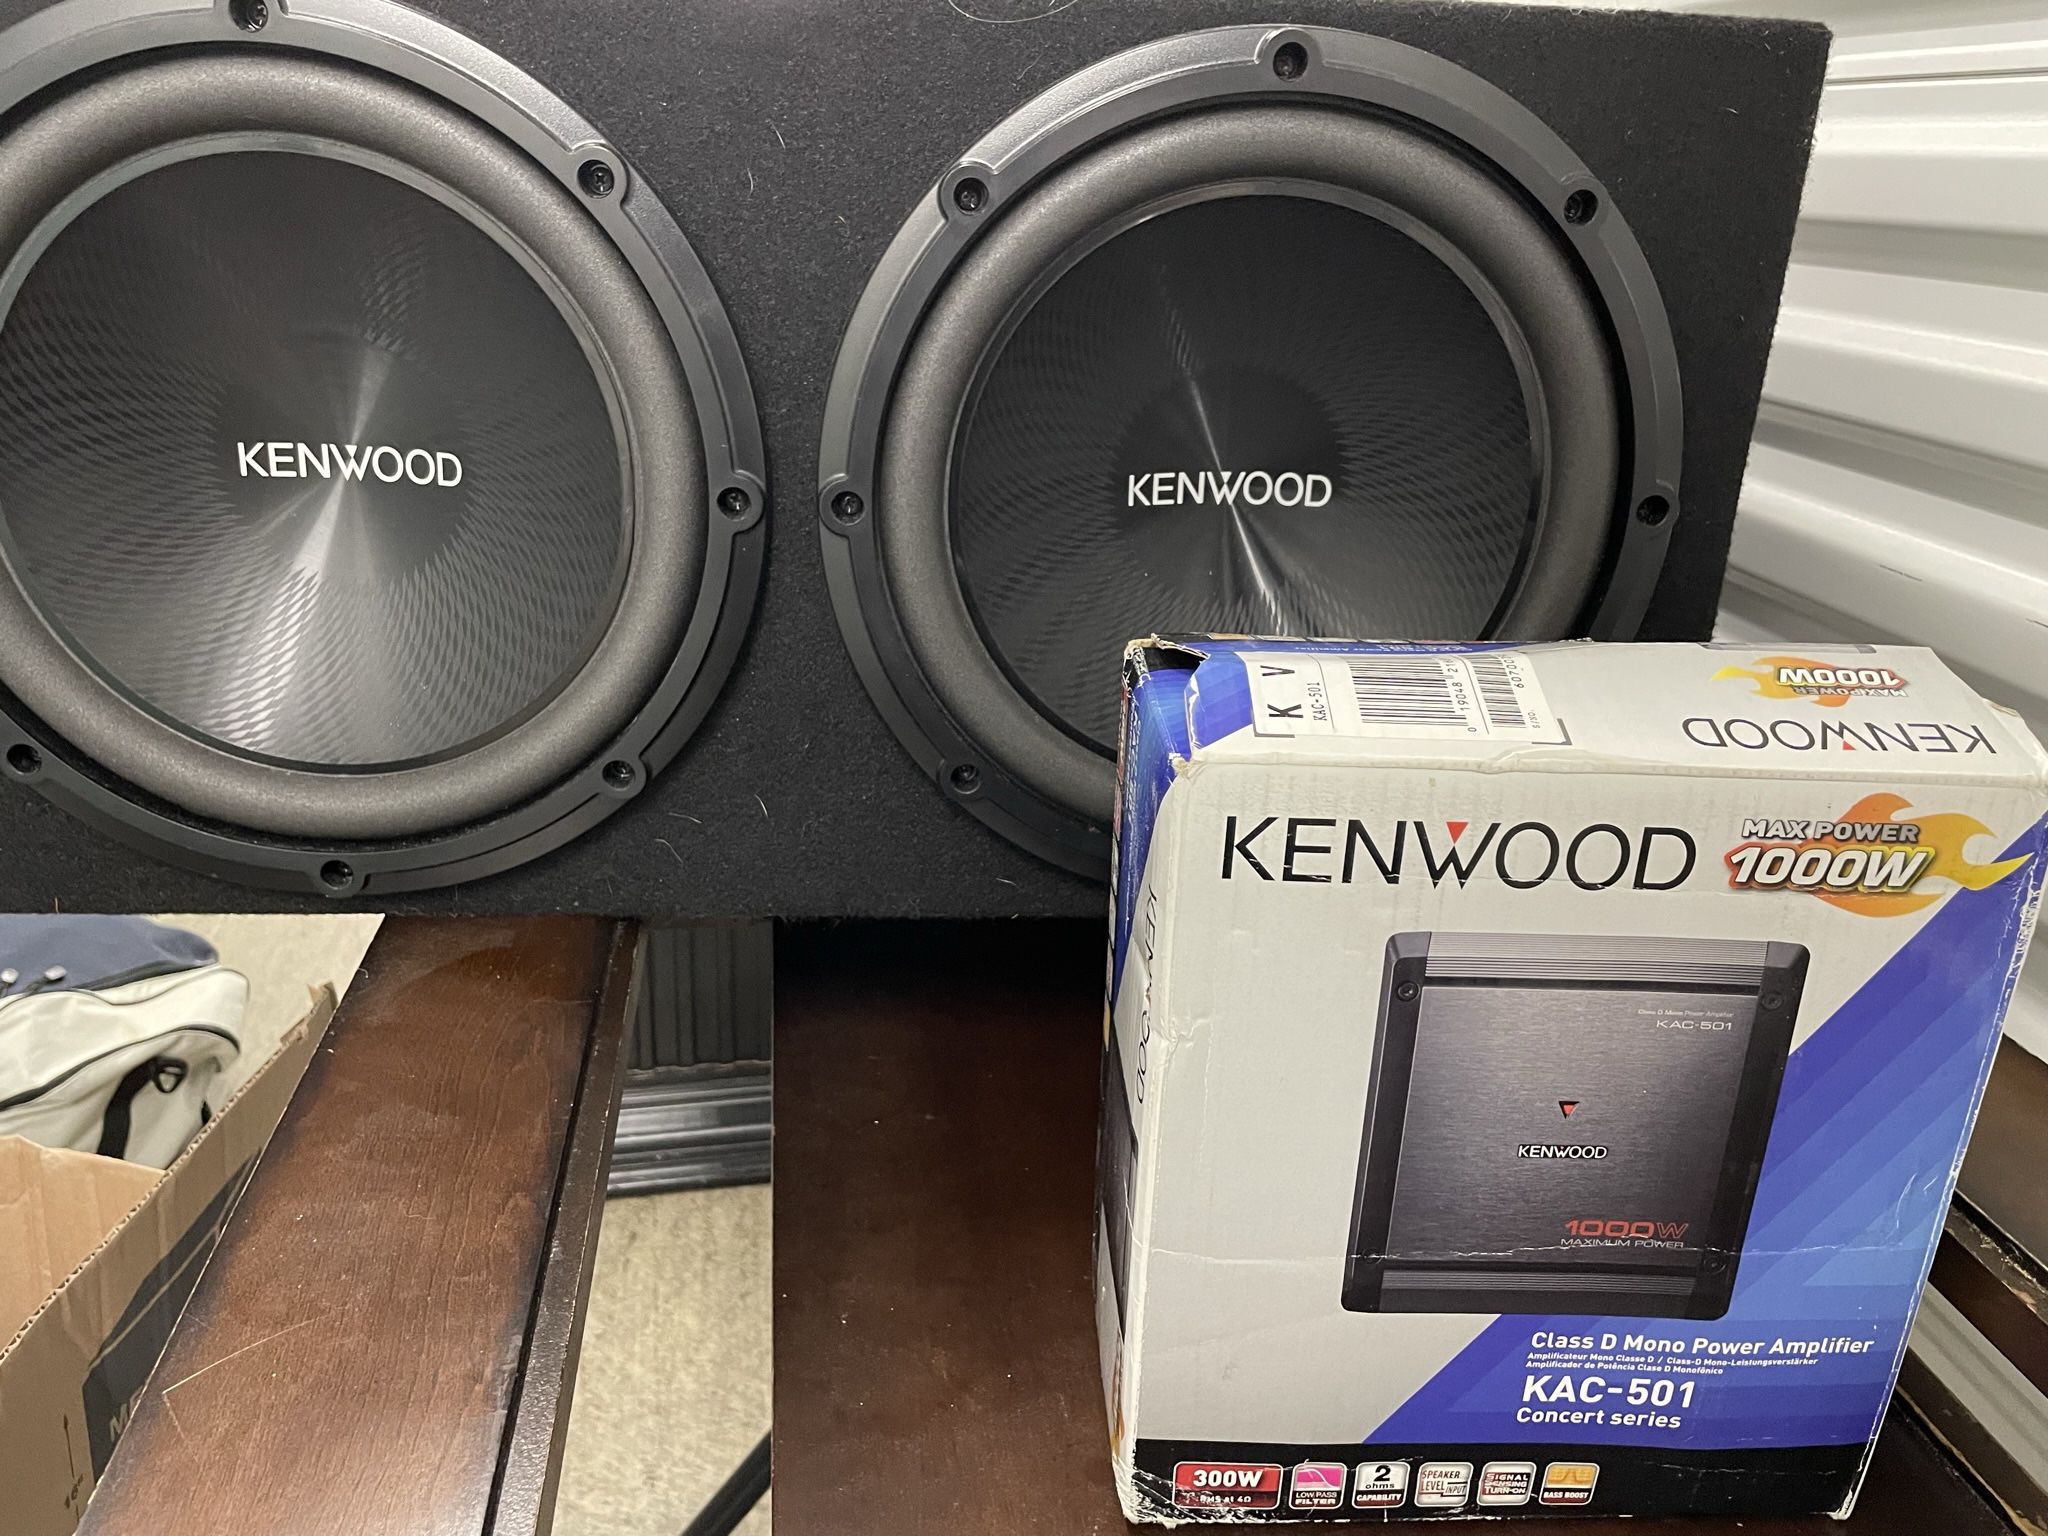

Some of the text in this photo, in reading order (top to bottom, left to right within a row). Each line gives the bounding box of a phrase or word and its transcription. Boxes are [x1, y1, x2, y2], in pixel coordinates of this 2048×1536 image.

[236, 440, 464, 489] KENWOOD
[1127, 469, 1333, 509] KENWOOD
[1779, 666, 1902, 687] 1000W
[1261, 665, 1304, 719] K V
[1452, 681, 1471, 711] 19048
[1791, 687, 1908, 697] MAX POWER
[1307, 681, 1328, 722] KAC-501
[1681, 716, 1998, 755] KENWOOD
[1741, 818, 1920, 844] MAX POWER
[1222, 815, 1697, 891] KENWOOD
[1729, 846, 1930, 890] 1000W
[1656, 1020, 1733, 1031] KAC-501
[1517, 1144, 1609, 1159] KENWOOD
[1564, 1219, 1689, 1239] 1000W
[1560, 1237, 1684, 1249] MAXIMUM POWER
[1531, 1331, 1875, 1358] Class D Mono Power Amplifier
[1526, 1360, 1582, 1369] Amplificador
[1597, 1361, 1635, 1370] Potência
[1637, 1363, 1663, 1372] Clase
[1527, 1352, 1588, 1361] Amplificateur
[1666, 1357, 1702, 1365] Class-D
[1704, 1357, 1819, 1367] Mono-Leistungsverstärker
[1522, 1374, 1696, 1409] KAC-501
[1516, 1407, 1682, 1429] Concert series
[1192, 1469, 1264, 1488] 300W
[1373, 1464, 1392, 1482] 2
[1421, 1470, 1461, 1479] SPEAKER
[1485, 1472, 1529, 1481] SIGNAL
[1421, 1480, 1445, 1492] LEVEL
[1445, 1485, 1466, 1495] INPUT
[1484, 1480, 1528, 1488] SENSING
[1484, 1486, 1527, 1494] TURN-ON
[1295, 1491, 1338, 1499] LOW PASS
[1356, 1493, 1402, 1502] CAPABILITY
[1543, 1491, 1589, 1499] BASS BOOST
